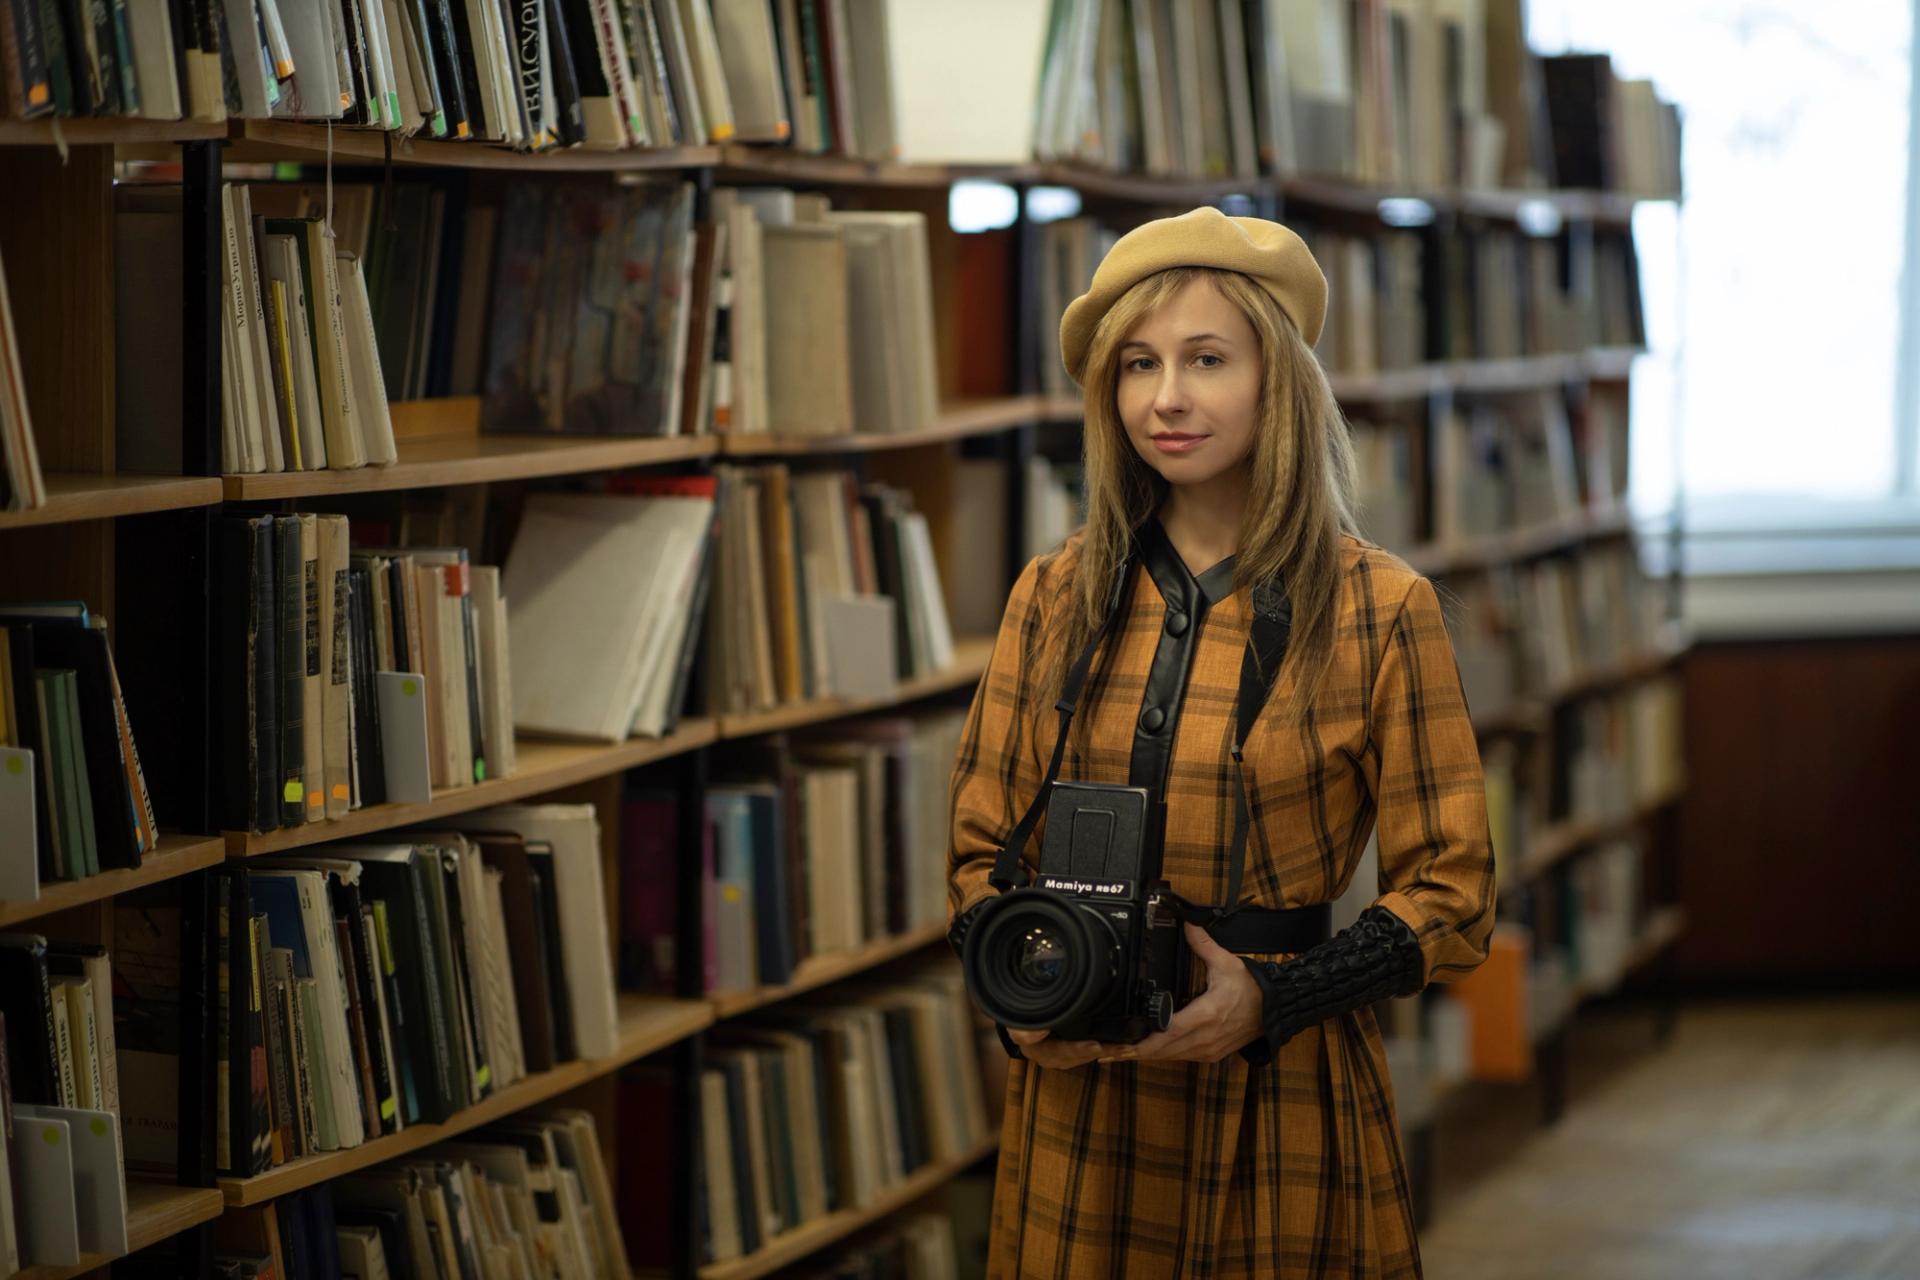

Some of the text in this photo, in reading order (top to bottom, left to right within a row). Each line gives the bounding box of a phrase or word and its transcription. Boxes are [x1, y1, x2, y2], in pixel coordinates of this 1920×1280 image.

[235, 284, 245, 328] Морис
[1045, 880, 1124, 894] Mamiya RB67
